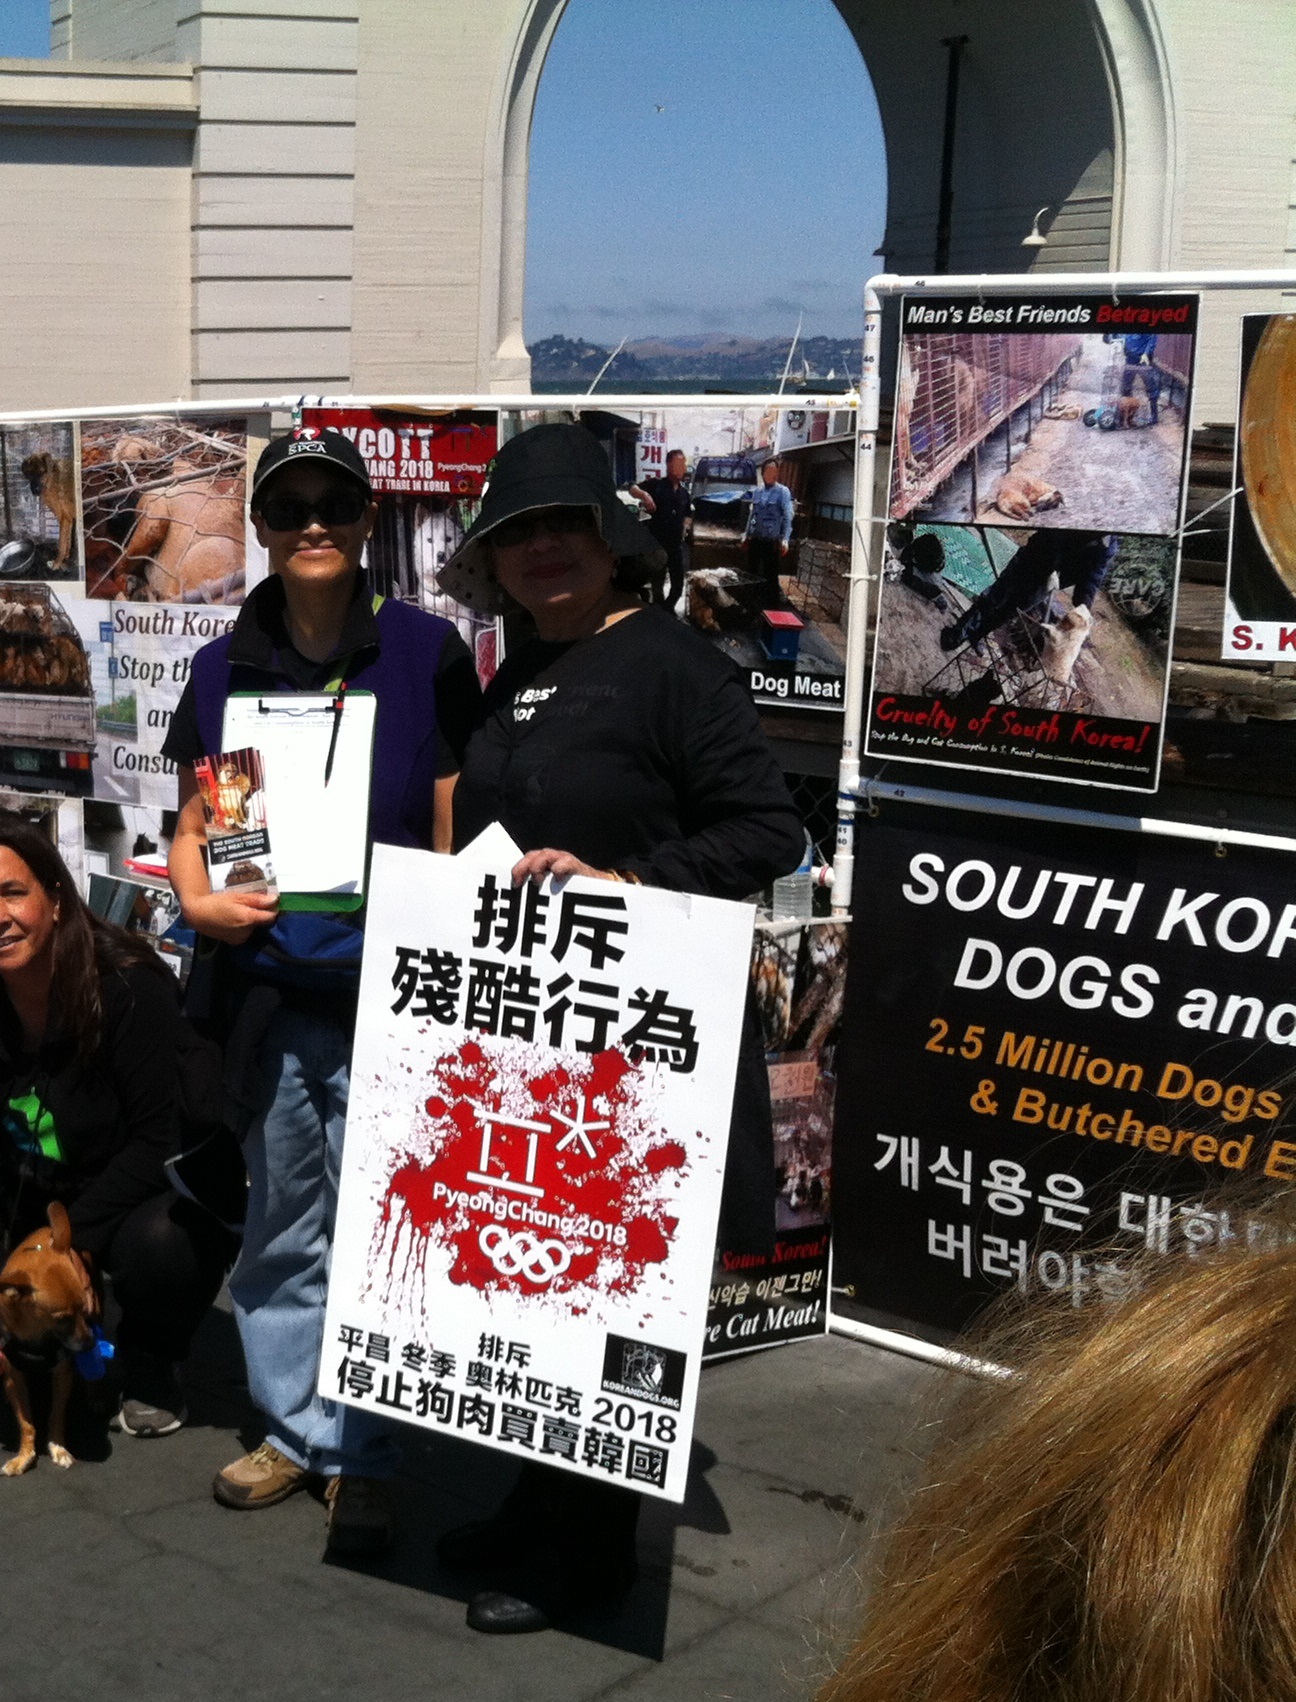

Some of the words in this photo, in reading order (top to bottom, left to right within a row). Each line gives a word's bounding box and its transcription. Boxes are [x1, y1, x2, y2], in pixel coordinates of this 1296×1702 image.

[907, 305, 964, 324] Man's
[967, 305, 1013, 324] Best
[1016, 304, 1091, 324] Friends
[1096, 303, 1189, 327] Betrayed
[400, 460, 434, 479] 2018
[115, 609, 175, 637] South
[1231, 625, 1263, 650] S.
[119, 655, 165, 687] Stop
[751, 672, 788, 695] Dog
[794, 676, 841, 698] Meat
[876, 697, 958, 737] Cruelty
[967, 706, 997, 737] of
[999, 709, 1061, 743] South
[1070, 719, 1152, 753] Korea!
[472, 874, 630, 970] 排斥
[902, 852, 1144, 935] SOUTH
[391, 946, 700, 1074] 殘酷行為
[954, 938, 1160, 1018] DOGS
[925, 1018, 985, 1060] 2.5
[995, 1032, 1144, 1092] Million
[1156, 1062, 1283, 1122] Dogs
[969, 1080, 998, 1116] &
[1012, 1087, 1255, 1172] Butchered
[432, 1182, 577, 1236] PyeongChang
[573, 1216, 628, 1246] 2018
[873, 1133, 1091, 1232] 개식용은
[478, 1332, 531, 1369] 排斥
[726, 1313, 760, 1339] Cat
[762, 1299, 821, 1333] Meat!
[338, 1324, 391, 1363] 平昌
[400, 1342, 457, 1380] 冬季
[466, 1361, 583, 1418] 奧林匹克
[592, 1397, 678, 1444] 2018
[337, 1356, 670, 1489] 停止狗肉買賣韓國
